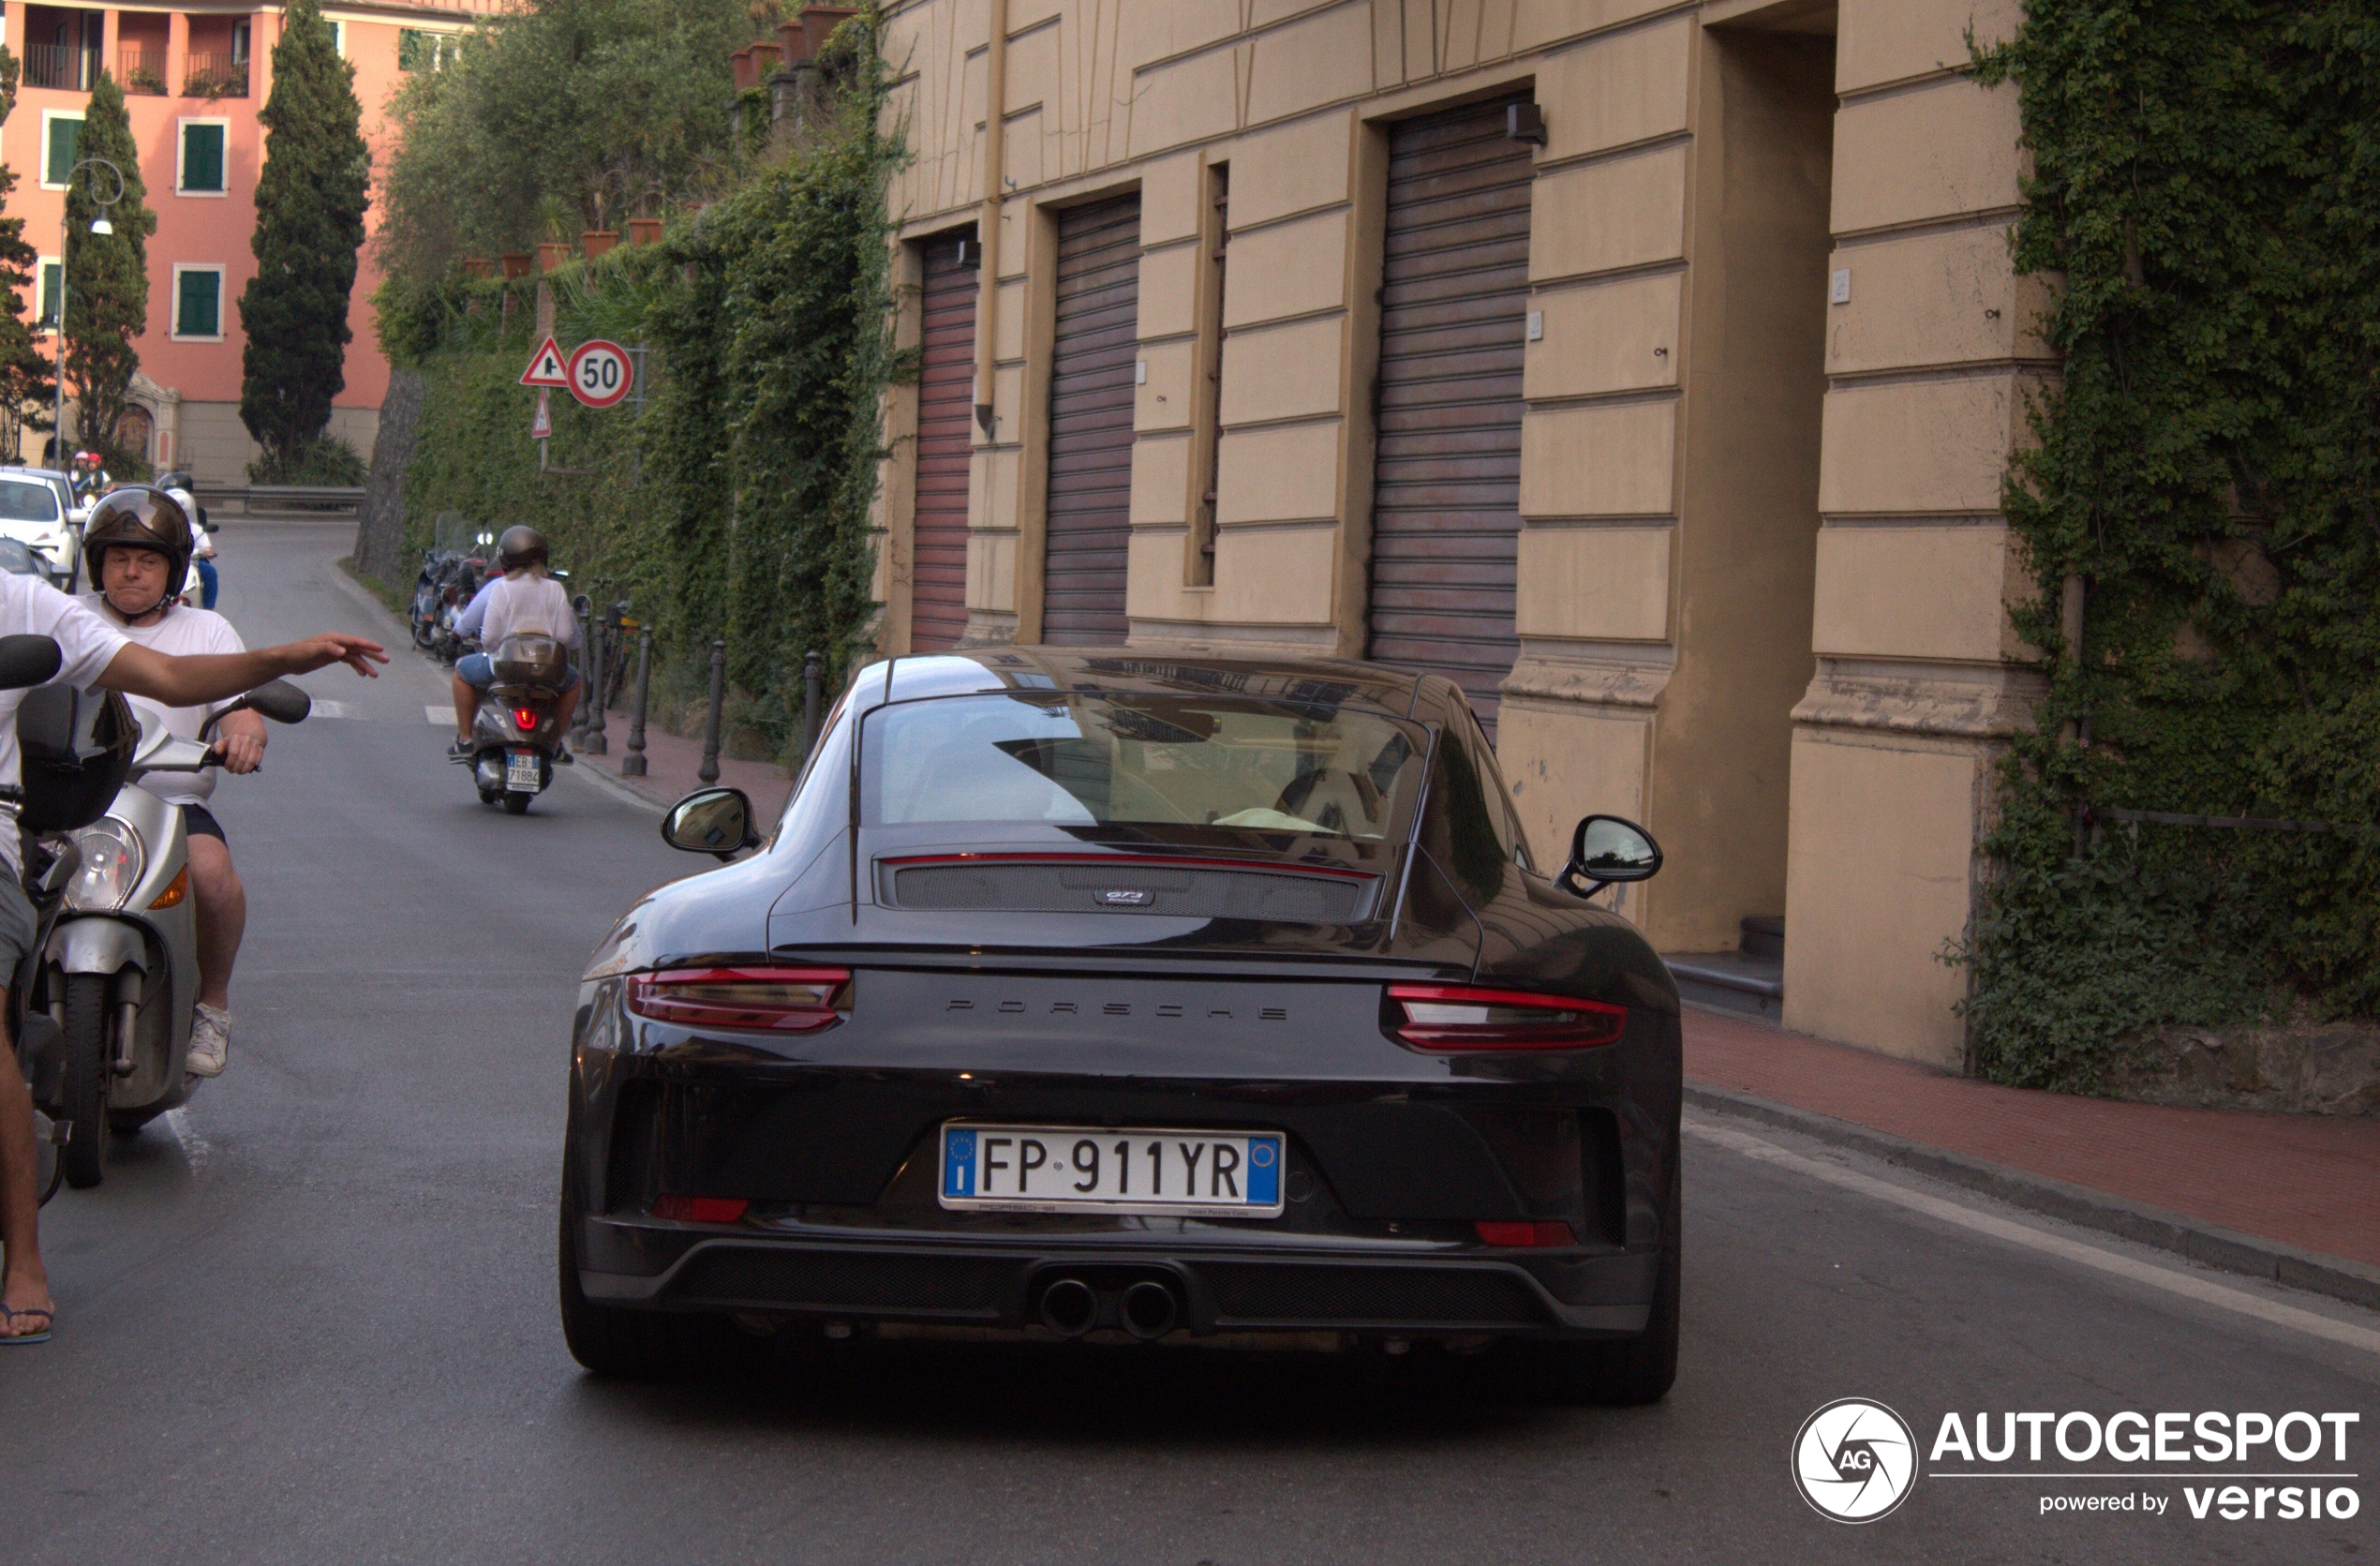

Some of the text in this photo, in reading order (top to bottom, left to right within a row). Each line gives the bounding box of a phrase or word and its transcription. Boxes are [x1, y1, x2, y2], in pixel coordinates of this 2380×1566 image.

[583, 358, 617, 389] 50
[515, 755, 528, 768] EB
[510, 769, 538, 783] 71884
[945, 999, 1287, 1021] PORSCHE
